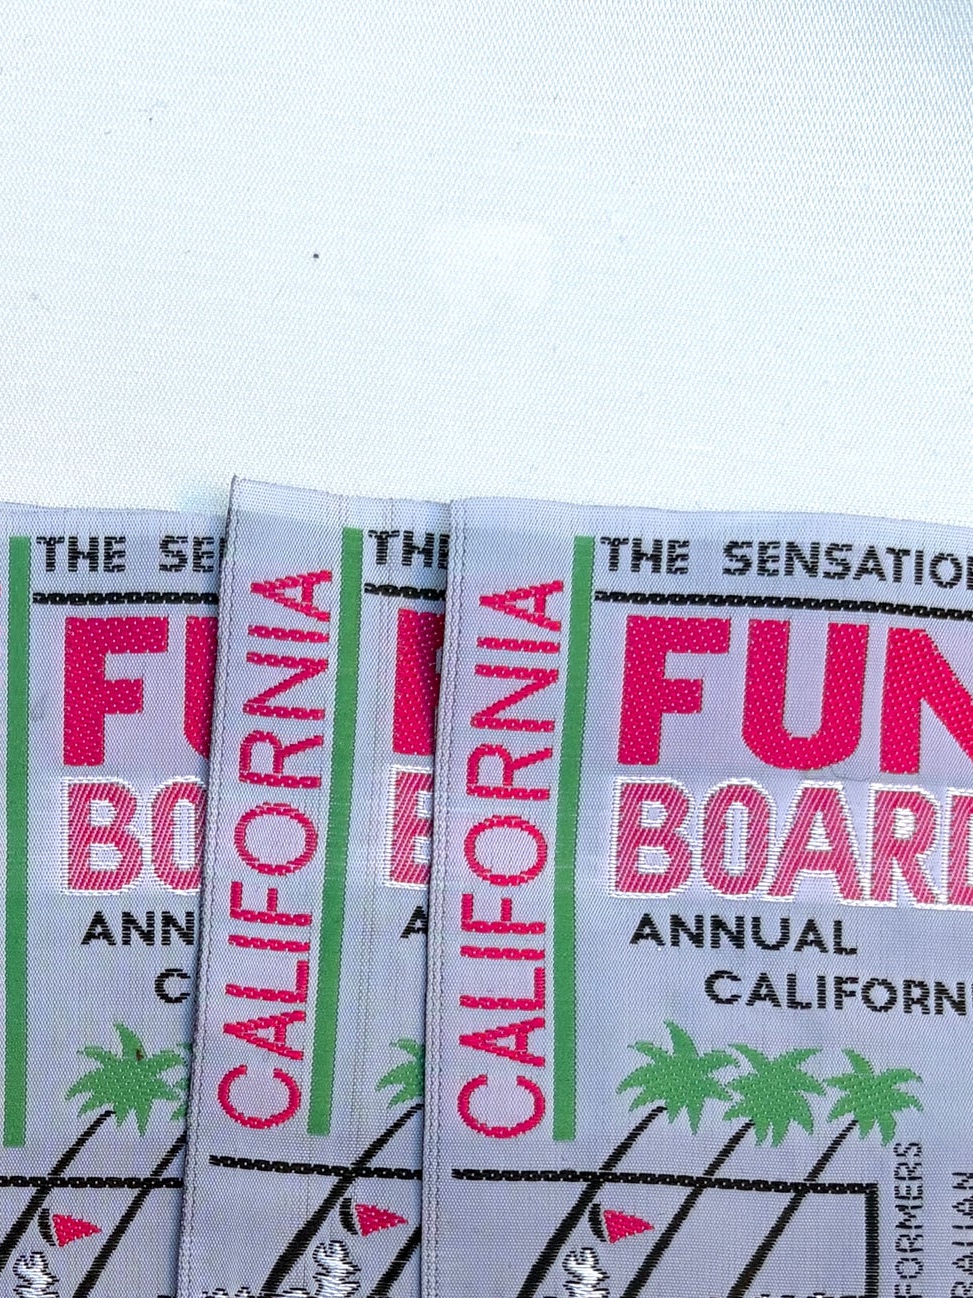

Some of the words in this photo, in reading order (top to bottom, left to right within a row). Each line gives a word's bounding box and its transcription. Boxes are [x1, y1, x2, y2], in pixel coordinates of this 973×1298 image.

[36, 536, 127, 574] THE
[601, 536, 690, 577] THE
[217, 569, 334, 1131] CALIFORNIA
[457, 579, 565, 1141] CALIFORNIA
[629, 913, 859, 957] ANNUAL
